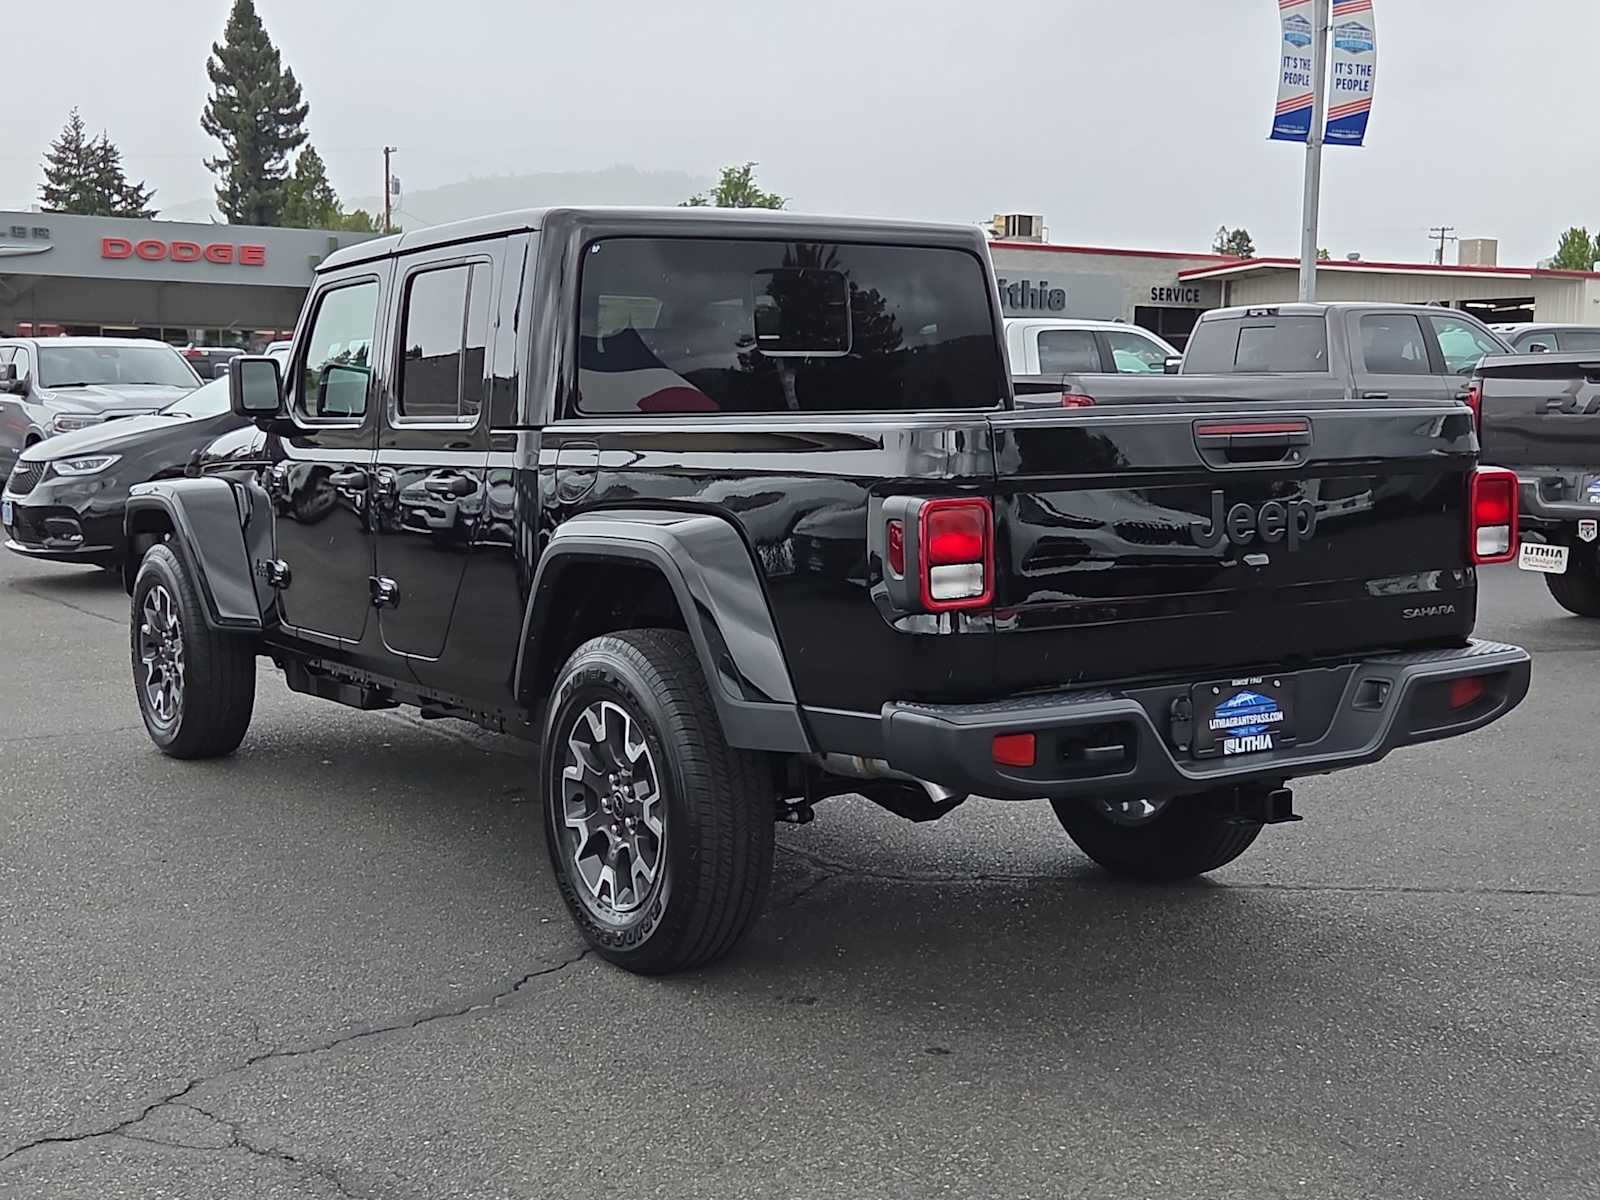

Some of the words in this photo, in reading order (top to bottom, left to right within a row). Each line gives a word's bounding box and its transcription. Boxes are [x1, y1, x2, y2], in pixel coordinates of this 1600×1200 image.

[1283, 56, 1298, 69] IT'S
[1300, 58, 1311, 71] THE
[1335, 63, 1353, 75] IT'S
[1355, 64, 1372, 77] THE
[1283, 72, 1310, 86] PEOPLE
[1336, 78, 1369, 92] PEOPLE
[101, 237, 267, 267] DODGE
[1151, 286, 1200, 304] SERVICE
[1188, 489, 1317, 552] Jeep
[1524, 545, 1563, 559] LITHIA
[1402, 603, 1456, 619] SAHARA
[1235, 734, 1273, 753] LITHIA
